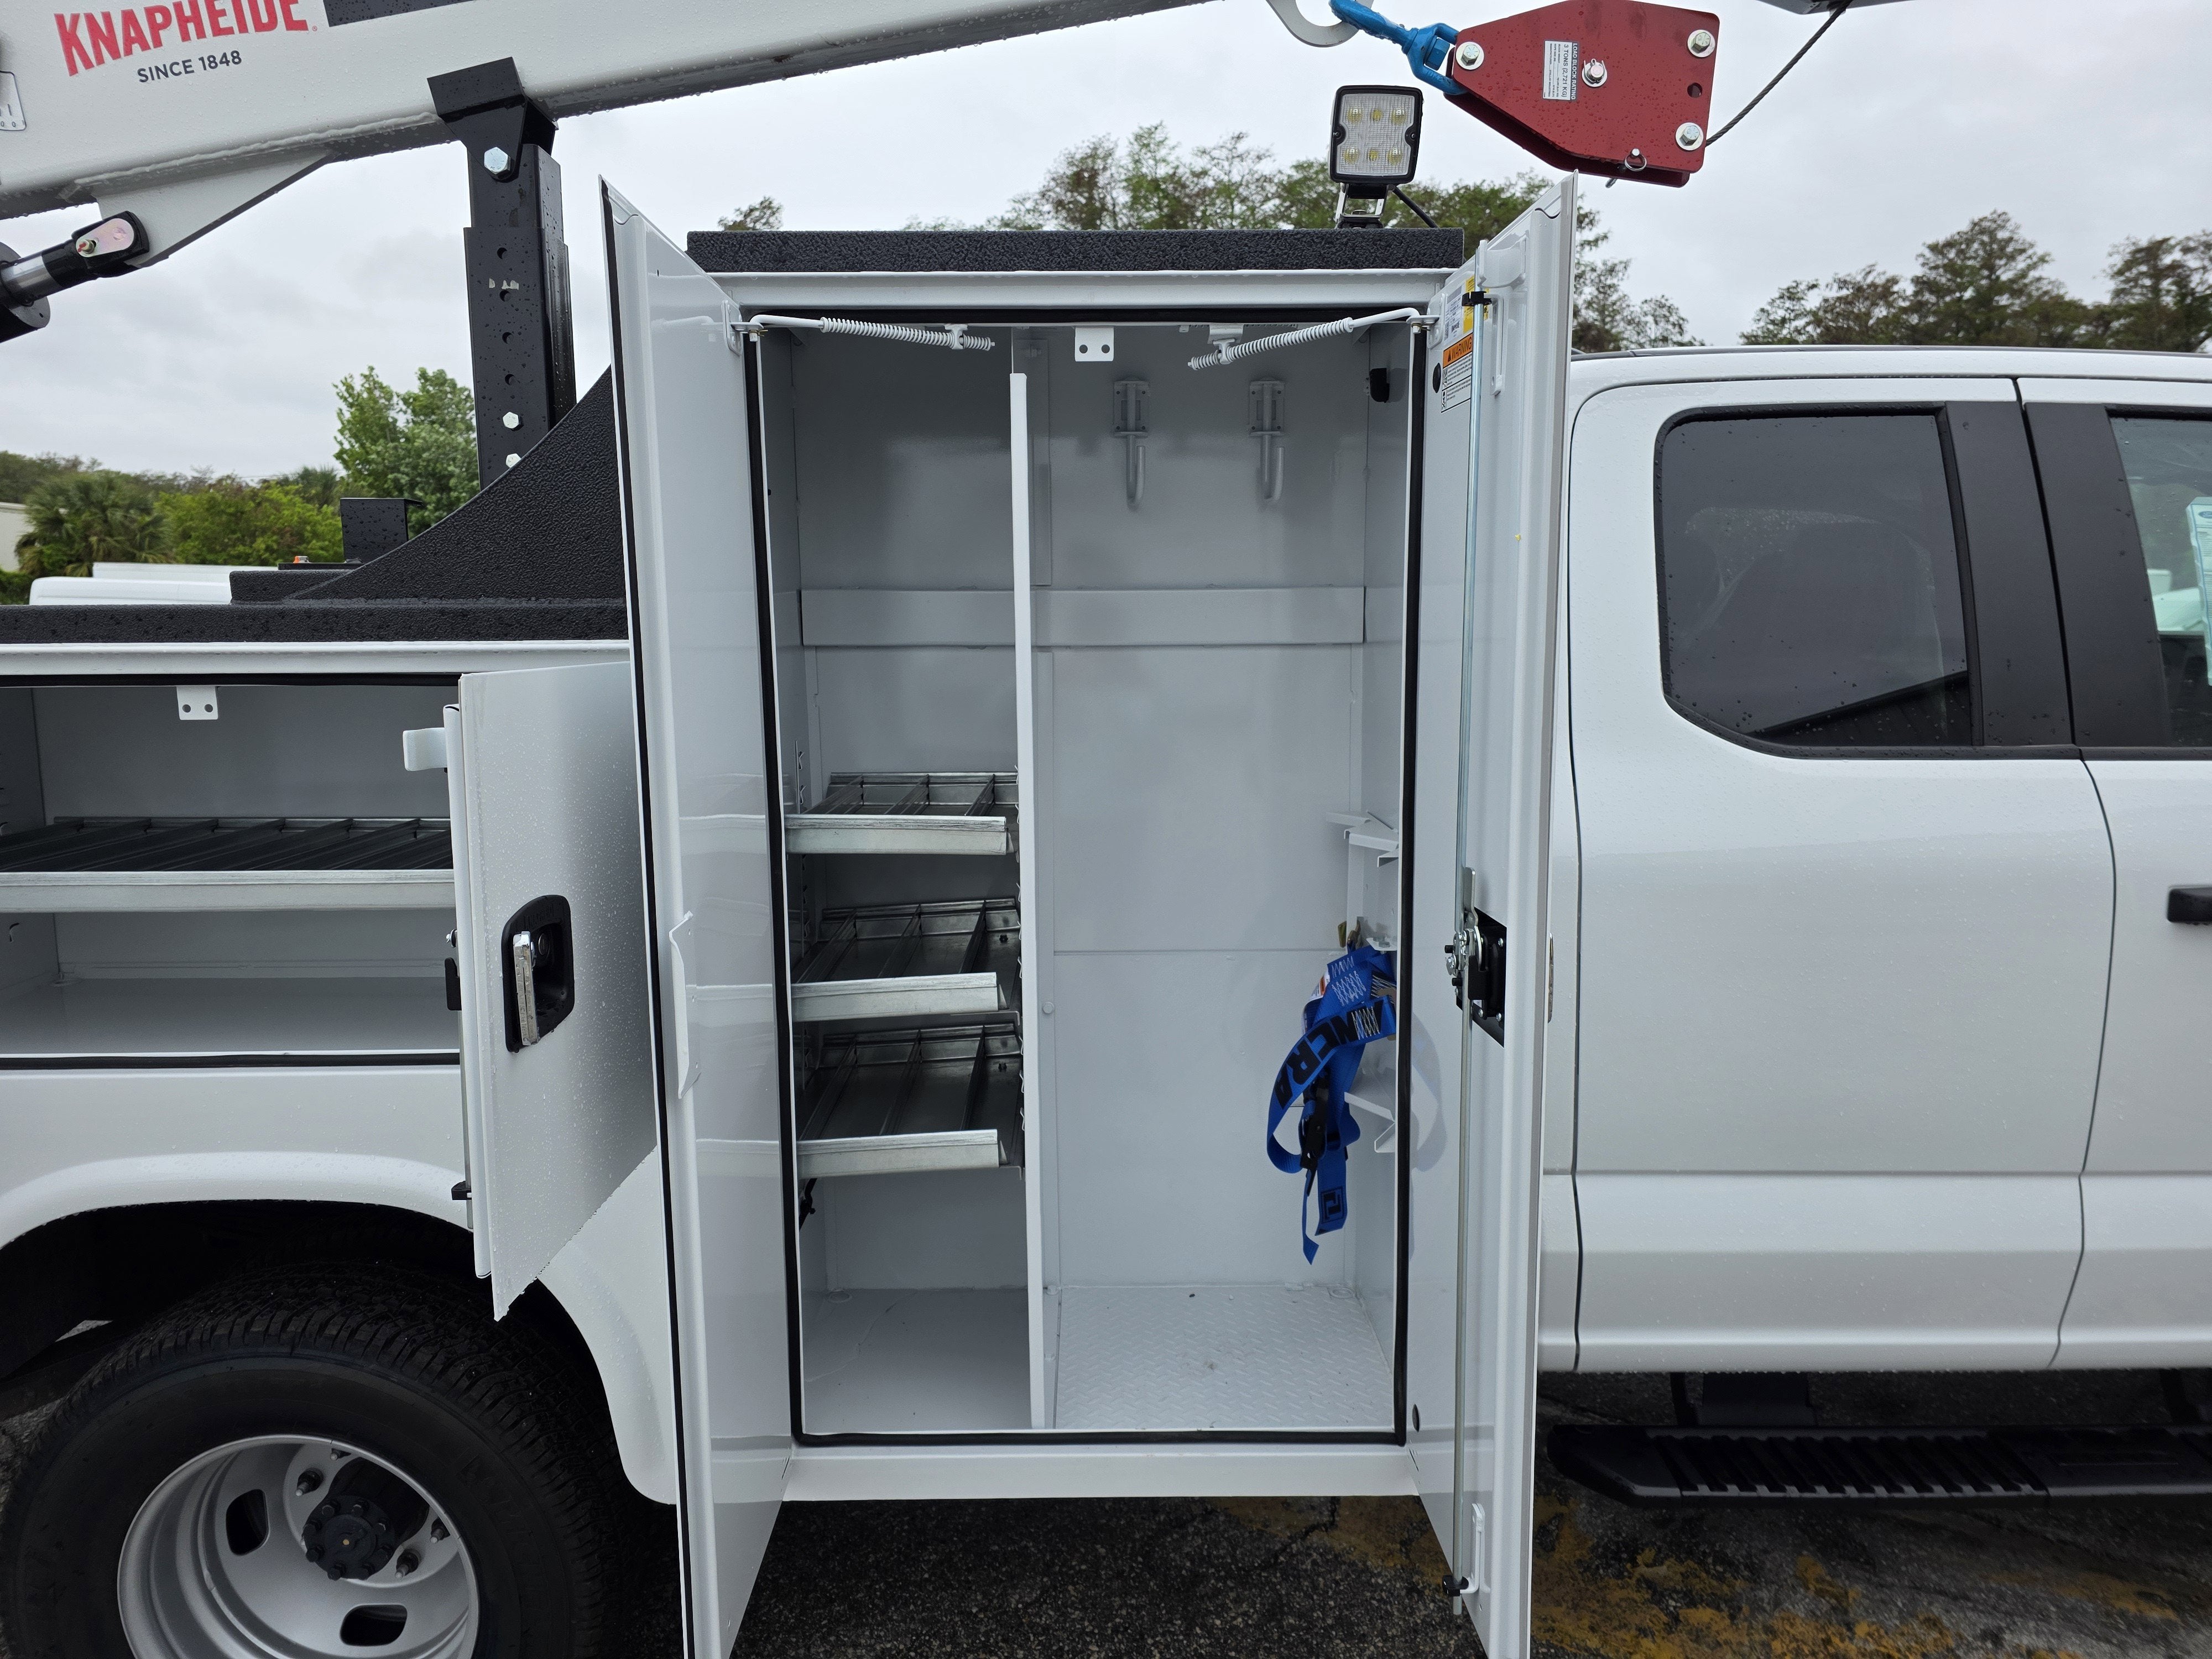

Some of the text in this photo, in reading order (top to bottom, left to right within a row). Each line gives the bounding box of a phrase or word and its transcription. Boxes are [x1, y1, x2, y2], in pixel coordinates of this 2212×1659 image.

[54, 0, 310, 76] KNAPHEIDE
[137, 50, 242, 83] SINCE 1848
[1452, 337, 1472, 361] WARNING
